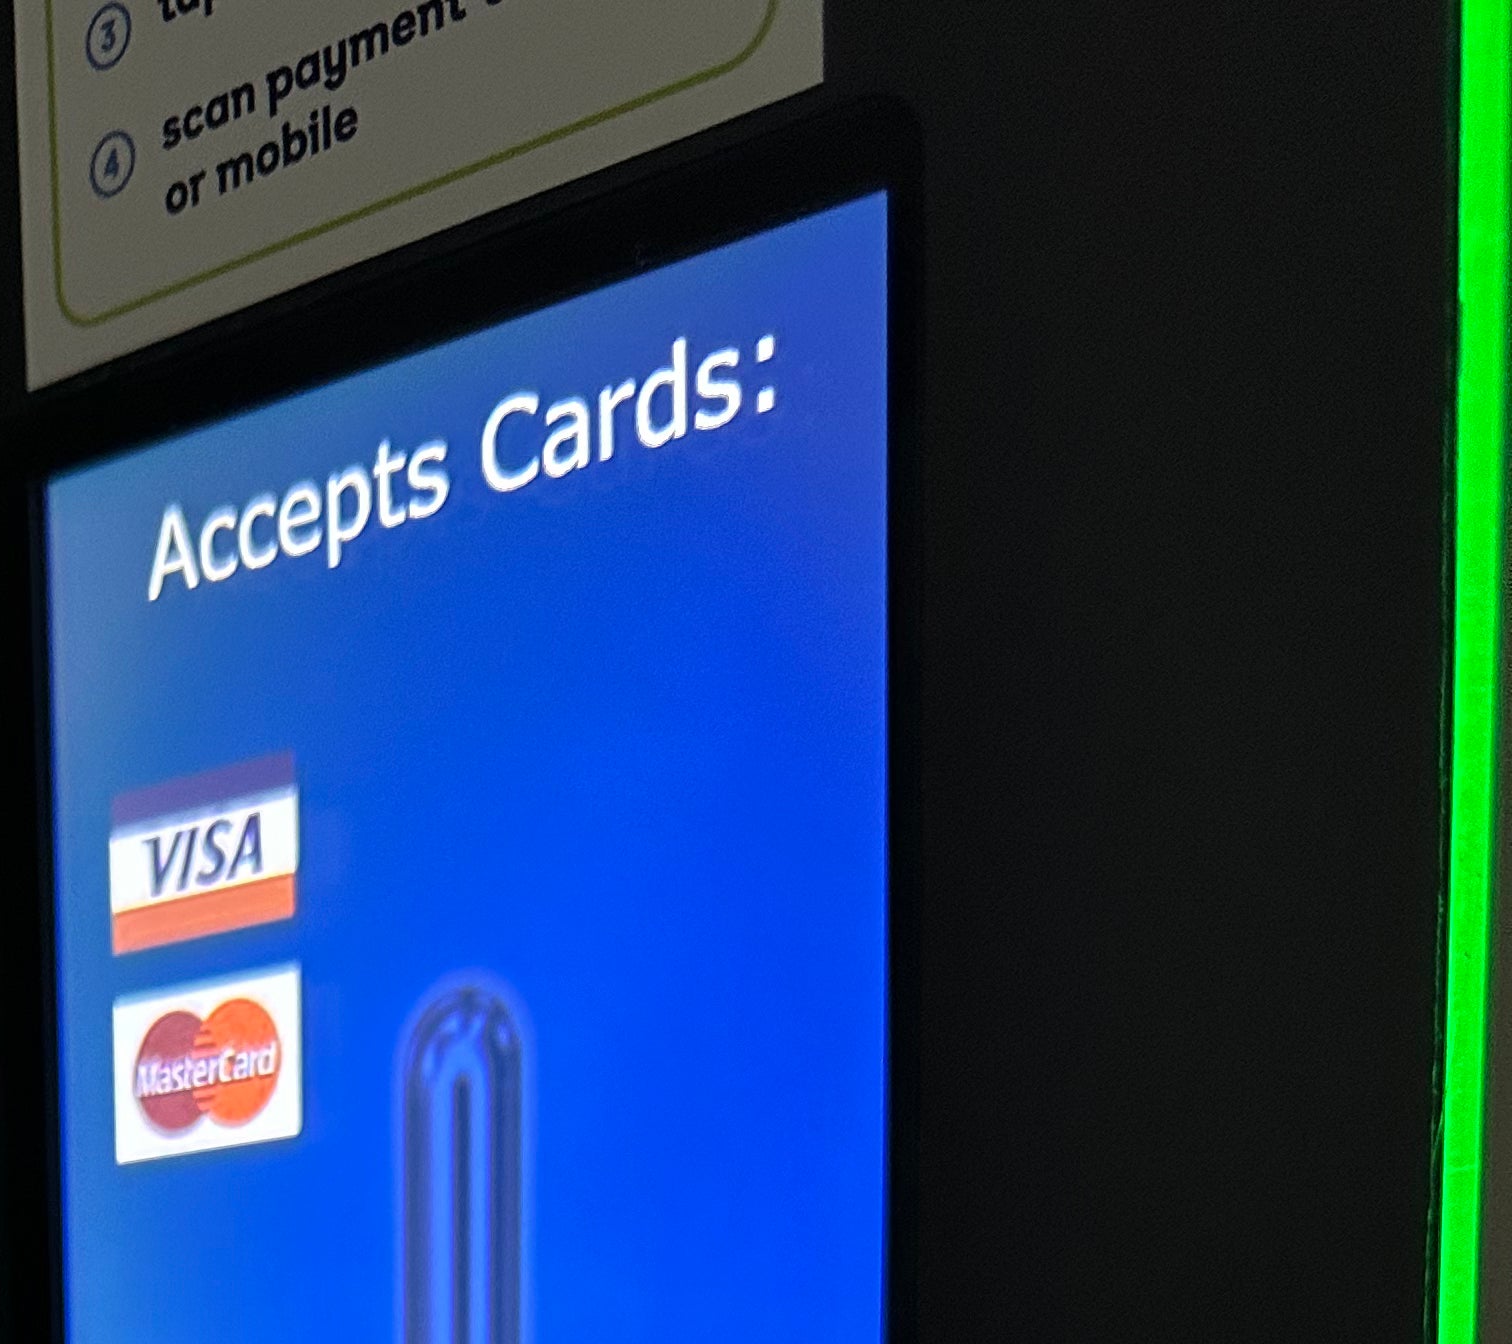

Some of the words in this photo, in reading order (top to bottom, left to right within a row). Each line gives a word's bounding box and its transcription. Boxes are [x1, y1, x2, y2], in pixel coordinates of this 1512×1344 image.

[100, 20, 117, 50] 3
[102, 147, 120, 178] 4
[161, 81, 256, 150] scan
[265, 0, 467, 117] payment
[165, 169, 207, 215] or
[216, 104, 359, 195] mobile
[146, 436, 450, 602] Accepts
[479, 333, 778, 494] Cards:
[142, 812, 264, 897] VISA
[134, 1042, 278, 1099] MasterCard
